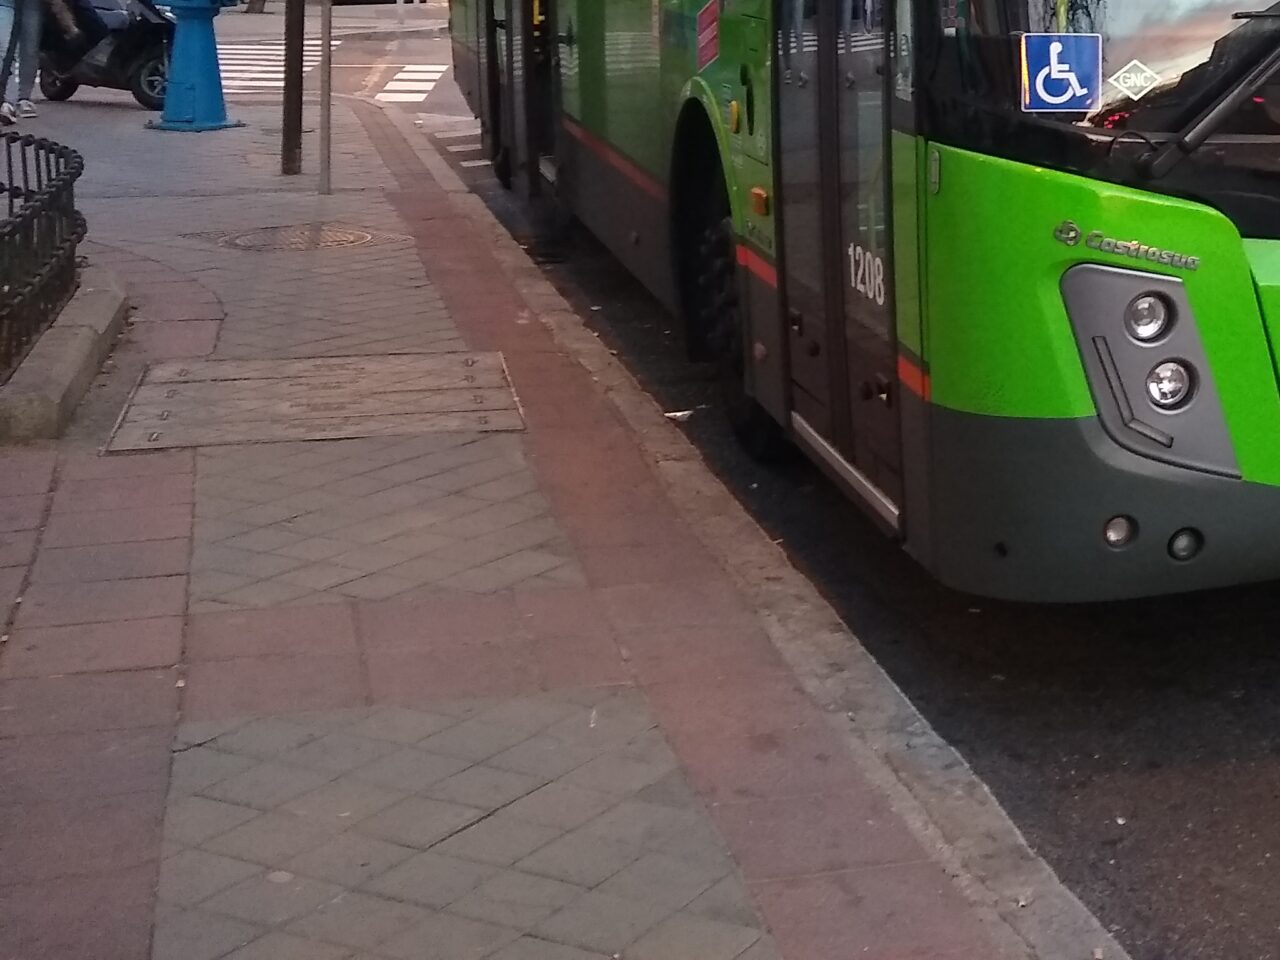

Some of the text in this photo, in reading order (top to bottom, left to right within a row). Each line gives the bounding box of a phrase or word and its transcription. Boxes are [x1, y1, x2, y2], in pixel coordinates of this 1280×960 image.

[1119, 72, 1151, 87] GNC
[1086, 230, 1201, 271] Castrosua
[848, 242, 885, 306] 1208
